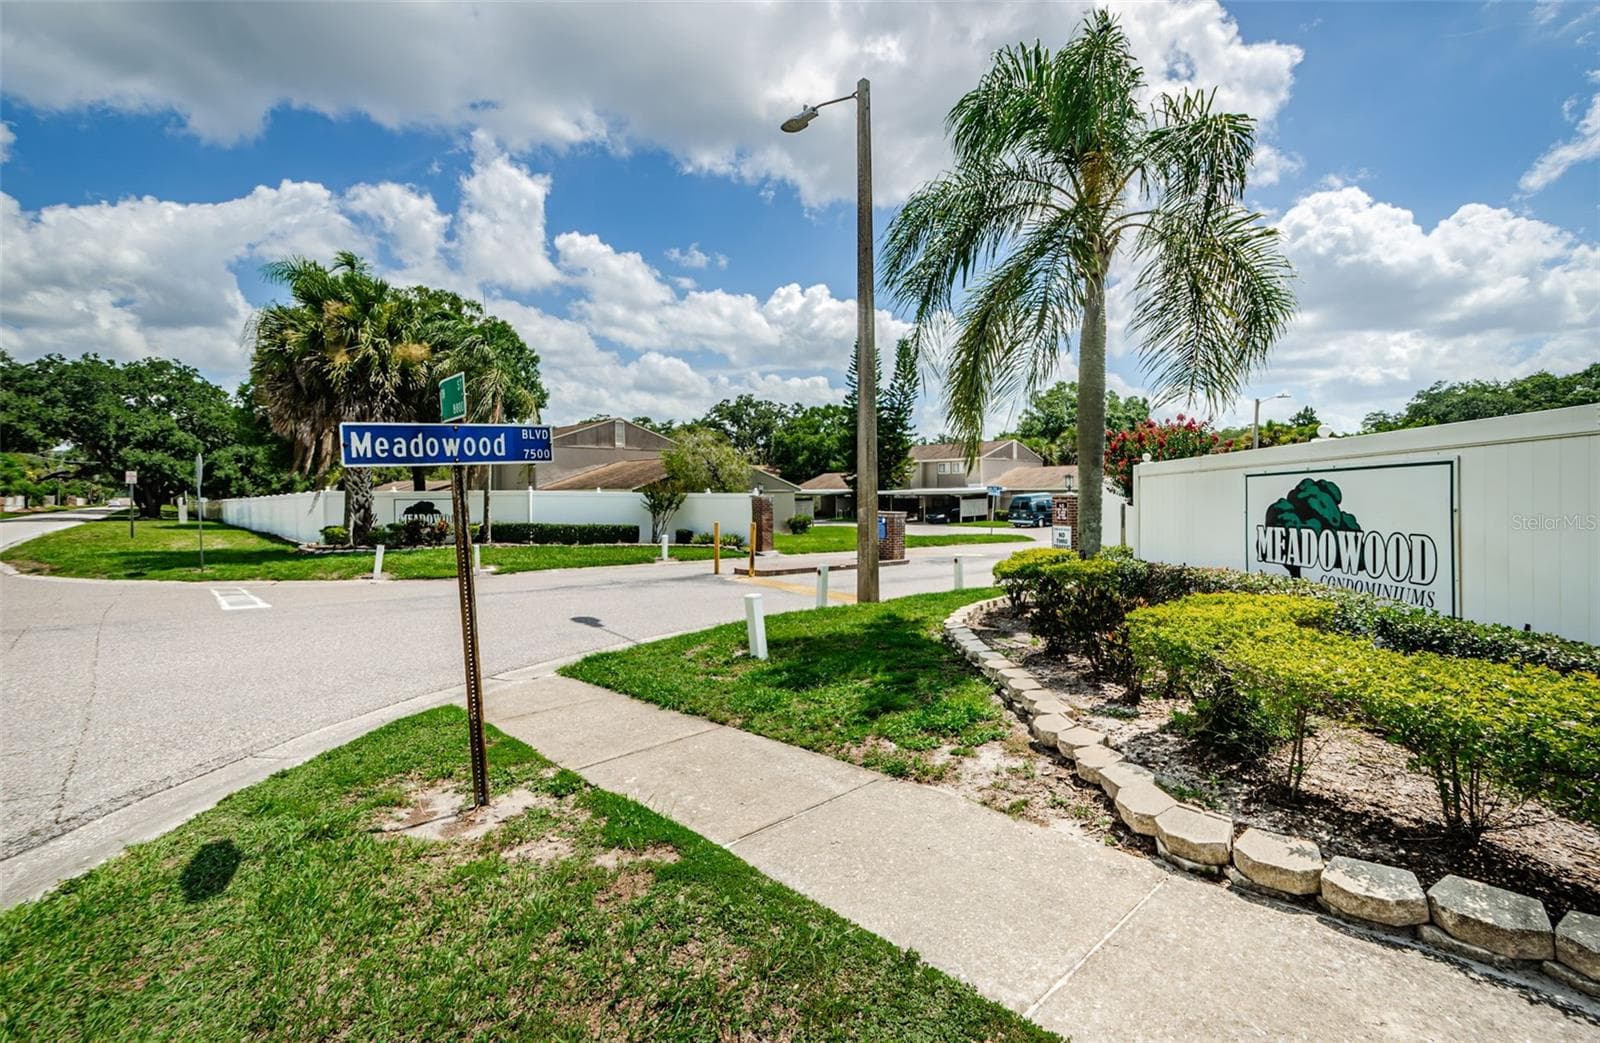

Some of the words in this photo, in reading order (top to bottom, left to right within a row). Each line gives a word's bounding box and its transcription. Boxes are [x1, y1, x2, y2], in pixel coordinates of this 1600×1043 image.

[521, 428, 549, 440] BLVD
[350, 431, 506, 458] Meadowood
[523, 448, 550, 460] 7500
[1256, 525, 1438, 586] MEADOWOOD
